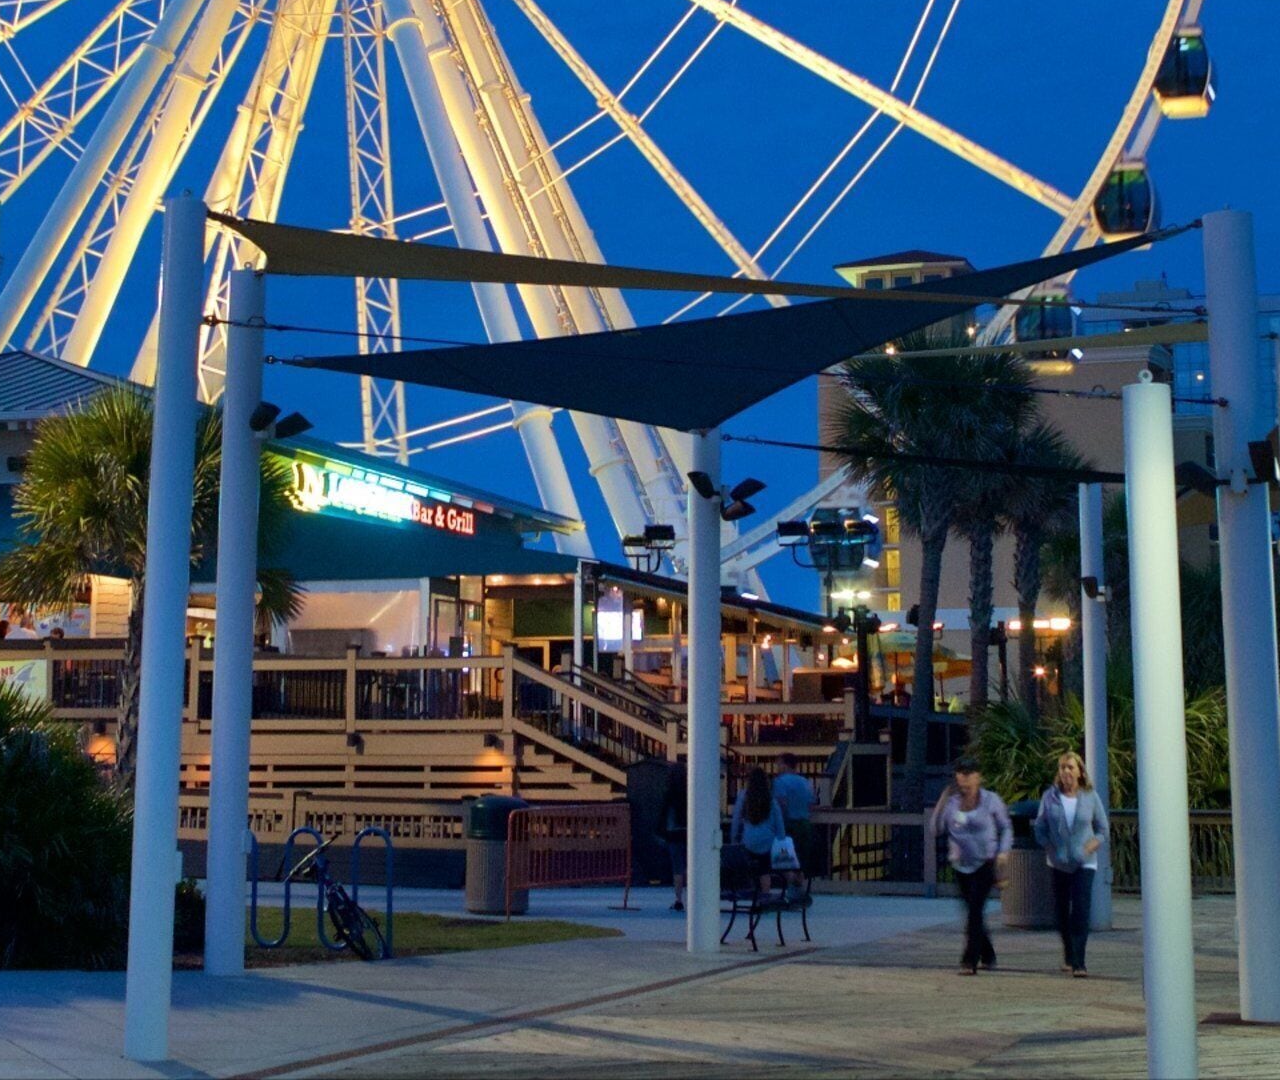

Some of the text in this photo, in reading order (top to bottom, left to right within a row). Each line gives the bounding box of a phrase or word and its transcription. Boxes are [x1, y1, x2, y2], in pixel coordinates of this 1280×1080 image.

[412, 500, 474, 534] Bar & Grill
